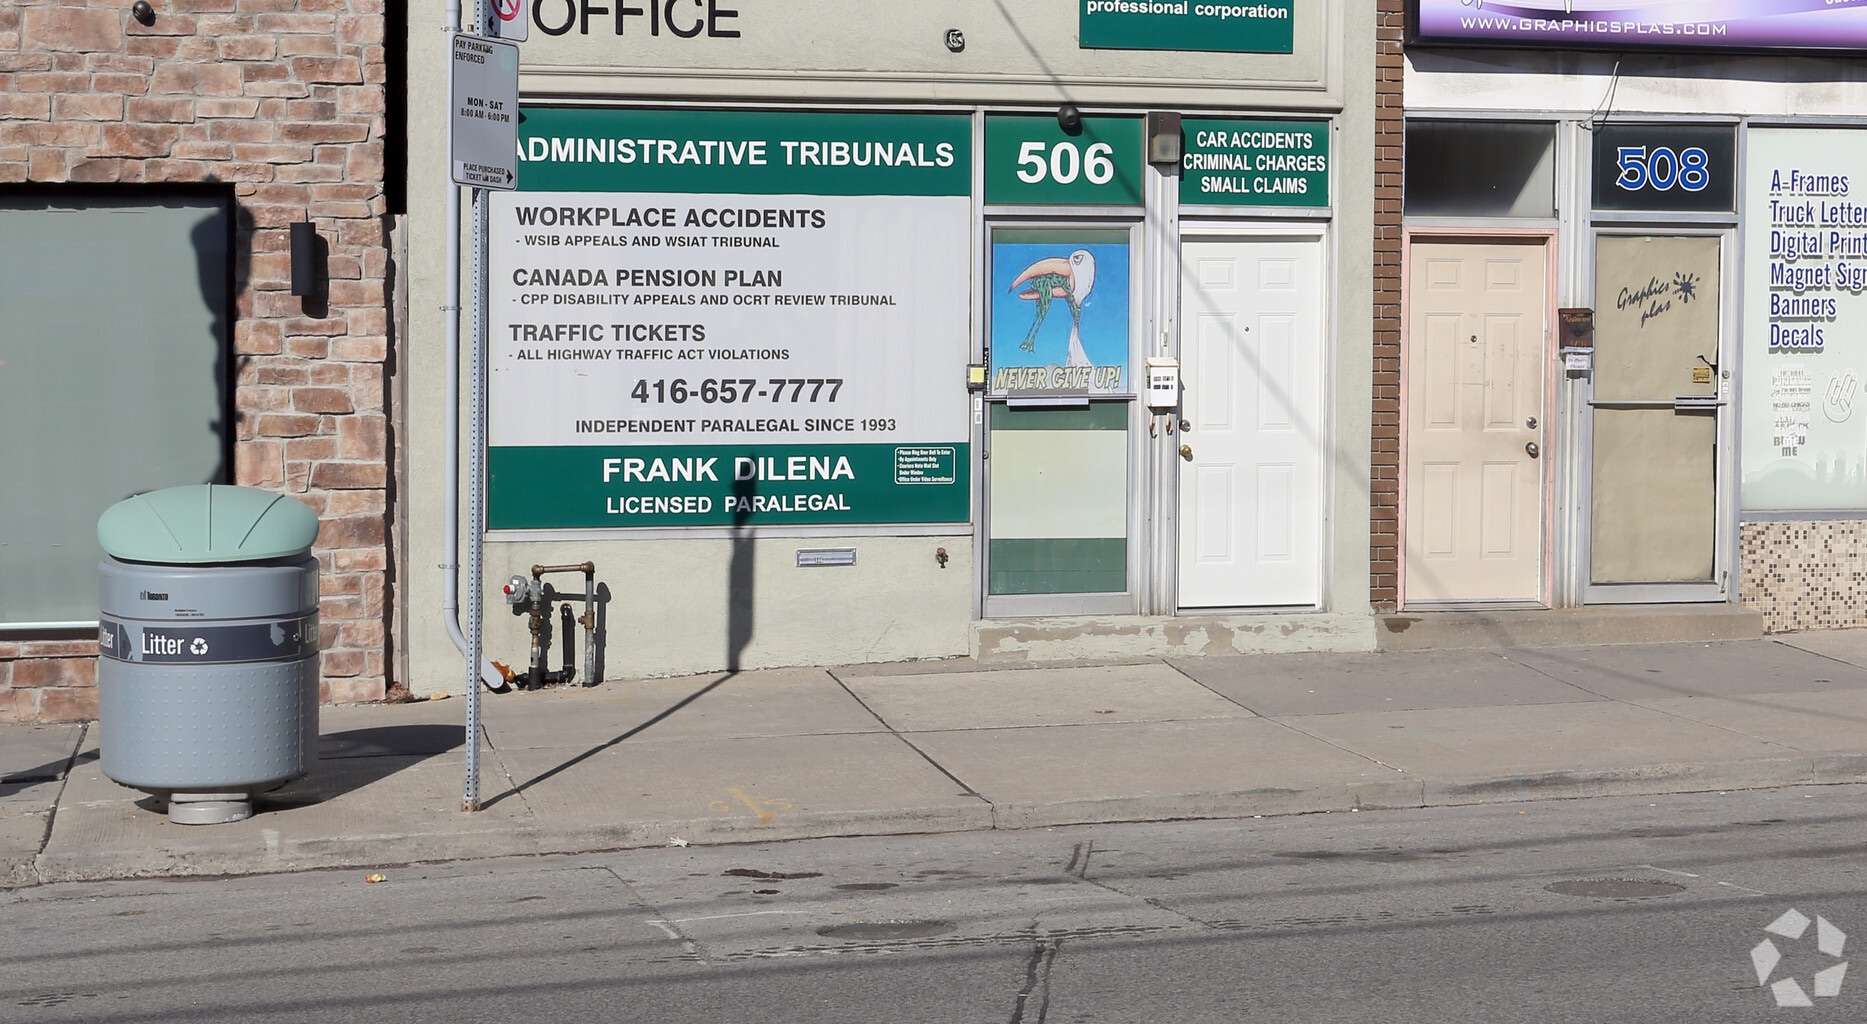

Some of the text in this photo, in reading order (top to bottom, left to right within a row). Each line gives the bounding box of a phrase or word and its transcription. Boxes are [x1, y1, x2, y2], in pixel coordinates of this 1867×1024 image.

[1194, 3, 1288, 20] corporation
[1460, 16, 1727, 36] WWW.GRAPHICSPLAS.COM
[455, 39, 494, 55] PAY PARKNG
[455, 51, 485, 64] ENFORCED
[467, 97, 504, 111] MON SAT
[460, 108, 510, 123] 8:00 AM 6:00 PM
[1196, 130, 1313, 150] CAR ACCIDENTS
[780, 141, 955, 167] TRIBUNALS
[1016, 141, 1115, 185] 506
[1183, 153, 1326, 172] CRIMINAL CHARGES
[463, 162, 478, 172] PLACE
[1616, 145, 1710, 192] 508
[1200, 176, 1308, 194] SMALL CLAIMS
[1769, 169, 1849, 194] A-Frames
[515, 206, 826, 229] WORKPLACE ACCIDENTS
[1769, 199, 1815, 223] Truck
[524, 234, 780, 248] WSIB APPEALS AND WSIAT TRIBUNAL
[1770, 230, 1823, 259] Digital
[512, 268, 782, 287] CANADA PENSION PLAN
[1770, 262, 1831, 290] Magnet
[520, 293, 897, 306] CPP DISABILITY APPEALS AND OCRT REVIEW TRIBUNAL
[1617, 276, 1670, 311] Graphics
[1641, 300, 1671, 328] plas
[1770, 293, 1837, 316] Banners
[508, 323, 706, 343] TRAFFIC TICKETS
[1769, 323, 1824, 346] Decals
[516, 349, 790, 360] ALL HIGHWAY TRAFFIC ACT VIOLATIONS
[994, 366, 1047, 390] NEVER
[1051, 366, 1092, 389] GIVE
[1094, 365, 1122, 389] UP!
[630, 378, 844, 404] 416-657-7777
[576, 418, 896, 433] INDEPENDENT PARALEGAL SINCE 1993
[603, 455, 855, 483] FRANK DILENA
[606, 493, 851, 514] LICENSED PARALEGAL
[142, 632, 184, 655] Litter
